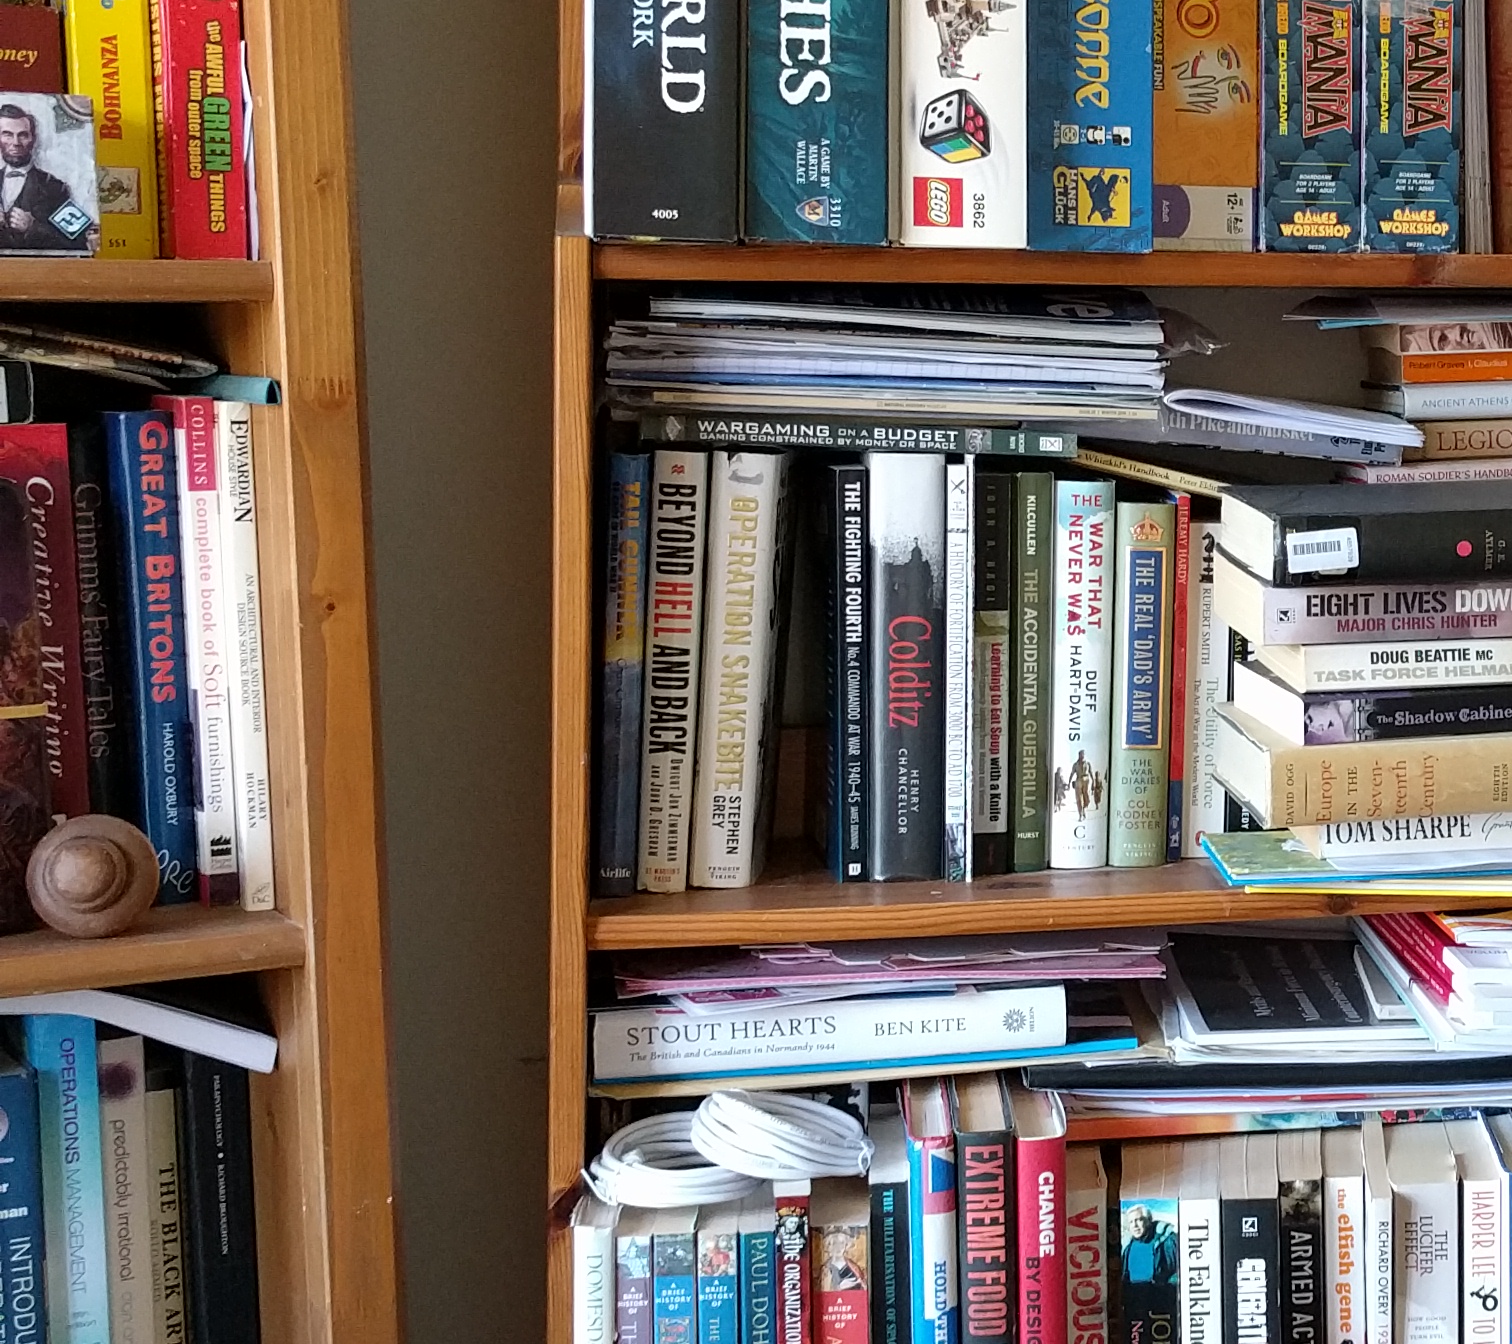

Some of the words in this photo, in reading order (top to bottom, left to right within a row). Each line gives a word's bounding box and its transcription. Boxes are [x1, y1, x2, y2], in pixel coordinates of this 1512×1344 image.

[204, 42, 225, 97] AWFUL
[201, 96, 232, 172] GREEN
[209, 174, 227, 233] THINGS
[652, 209, 679, 220] 4005
[927, 179, 950, 223] LEGO
[972, 193, 984, 229] 3862
[697, 420, 830, 437] WARGAMING
[838, 428, 855, 437] ON
[859, 429, 868, 437] A
[874, 428, 959, 443] BUDGET
[137, 421, 169, 538] GREAT
[656, 481, 697, 575] BEYOND
[145, 555, 177, 704] BRITONS
[654, 581, 692, 636] HELL
[1306, 591, 1375, 618] EIGHT
[1383, 590, 1447, 615] LIVES
[1337, 617, 1387, 633] MAJOR
[1393, 616, 1435, 631] CHRIS
[1440, 613, 1498, 629] HUNTER
[653, 644, 689, 693] AND
[888, 615, 931, 729] Colditz
[648, 696, 688, 756] BACK
[1324, 821, 1380, 845] TOM
[1383, 815, 1472, 841] SHARPE
[625, 1022, 721, 1048] STOUT
[729, 1016, 837, 1040] HEARTS
[874, 1020, 915, 1037] BEN
[921, 1017, 967, 1035] KITE
[60, 1038, 80, 1165] OPERATIONS
[159, 1164, 177, 1218] THE
[964, 1145, 1005, 1271] EXTREME
[1037, 1170, 1055, 1256] CHANGE
[65, 1169, 86, 1294] MANAGEMENT
[161, 1225, 181, 1292] BLACK
[1187, 1219, 1211, 1259] The
[1026, 1256, 1040, 1283] BY
[1289, 1230, 1314, 1306] ARMED
[967, 1274, 1004, 1337] FOOD
